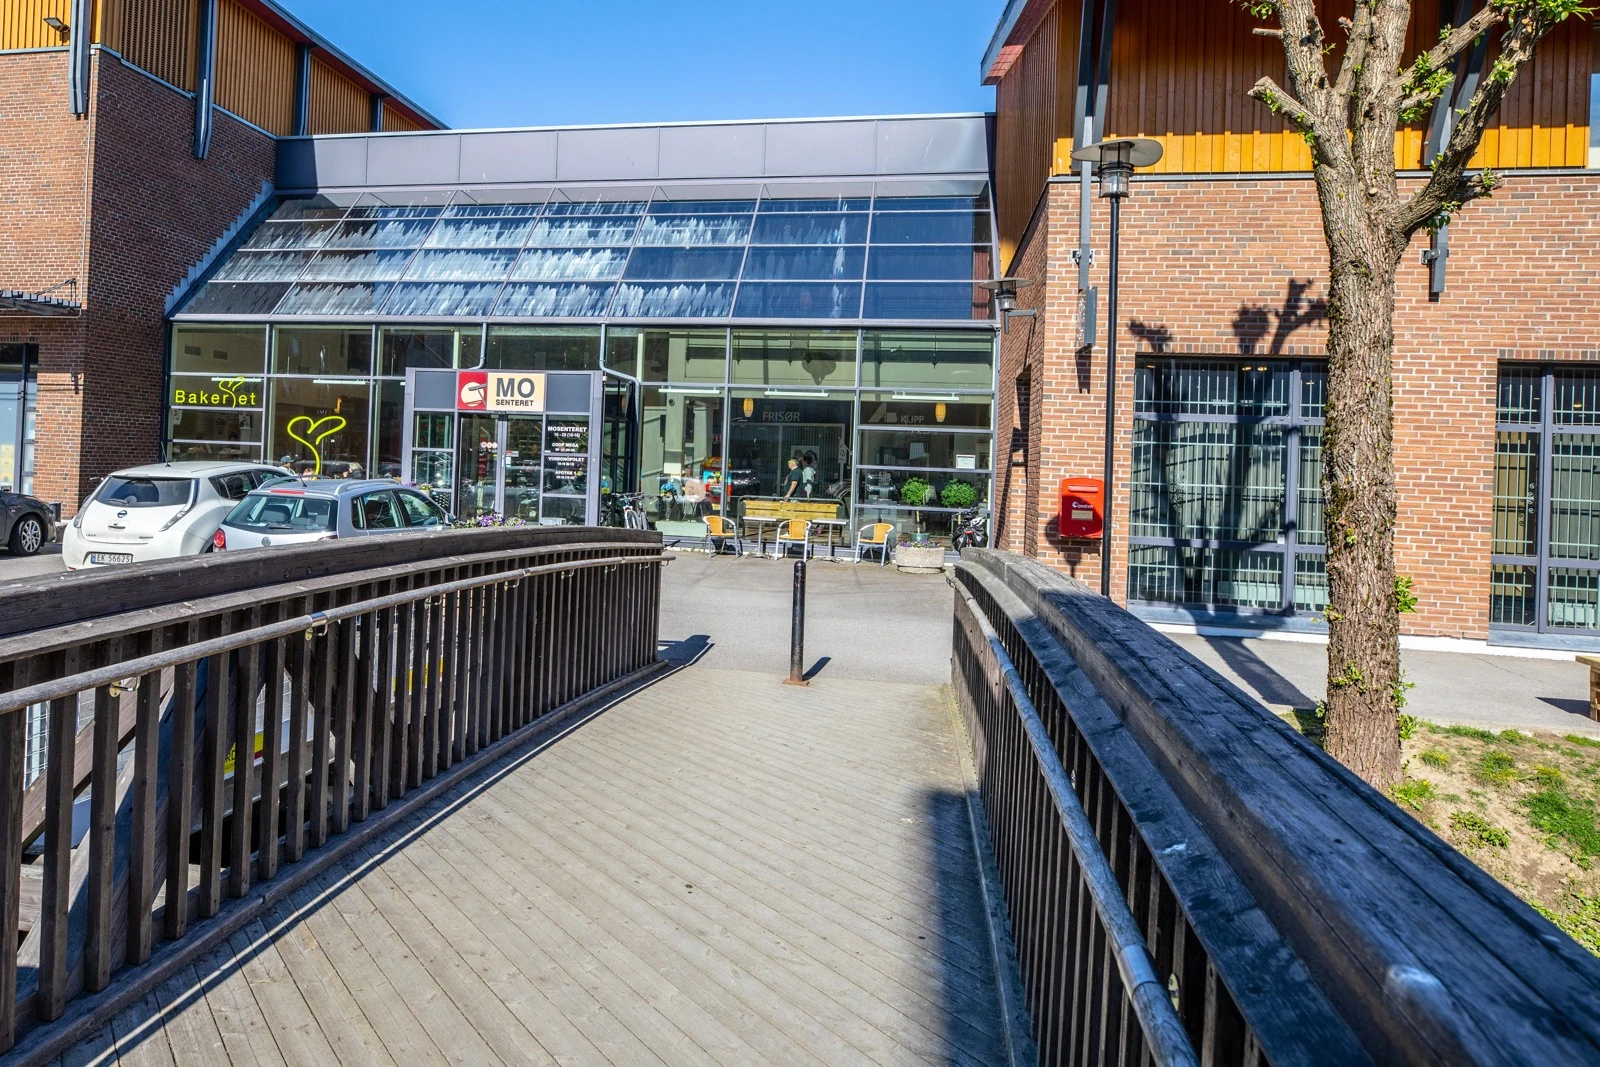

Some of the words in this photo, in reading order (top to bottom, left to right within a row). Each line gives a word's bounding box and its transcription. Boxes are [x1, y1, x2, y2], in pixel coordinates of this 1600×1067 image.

[496, 378, 535, 398] MO
[762, 411, 801, 422] FRISØR
[901, 415, 924, 424] KLIPP
[108, 555, 130, 563] 56625
